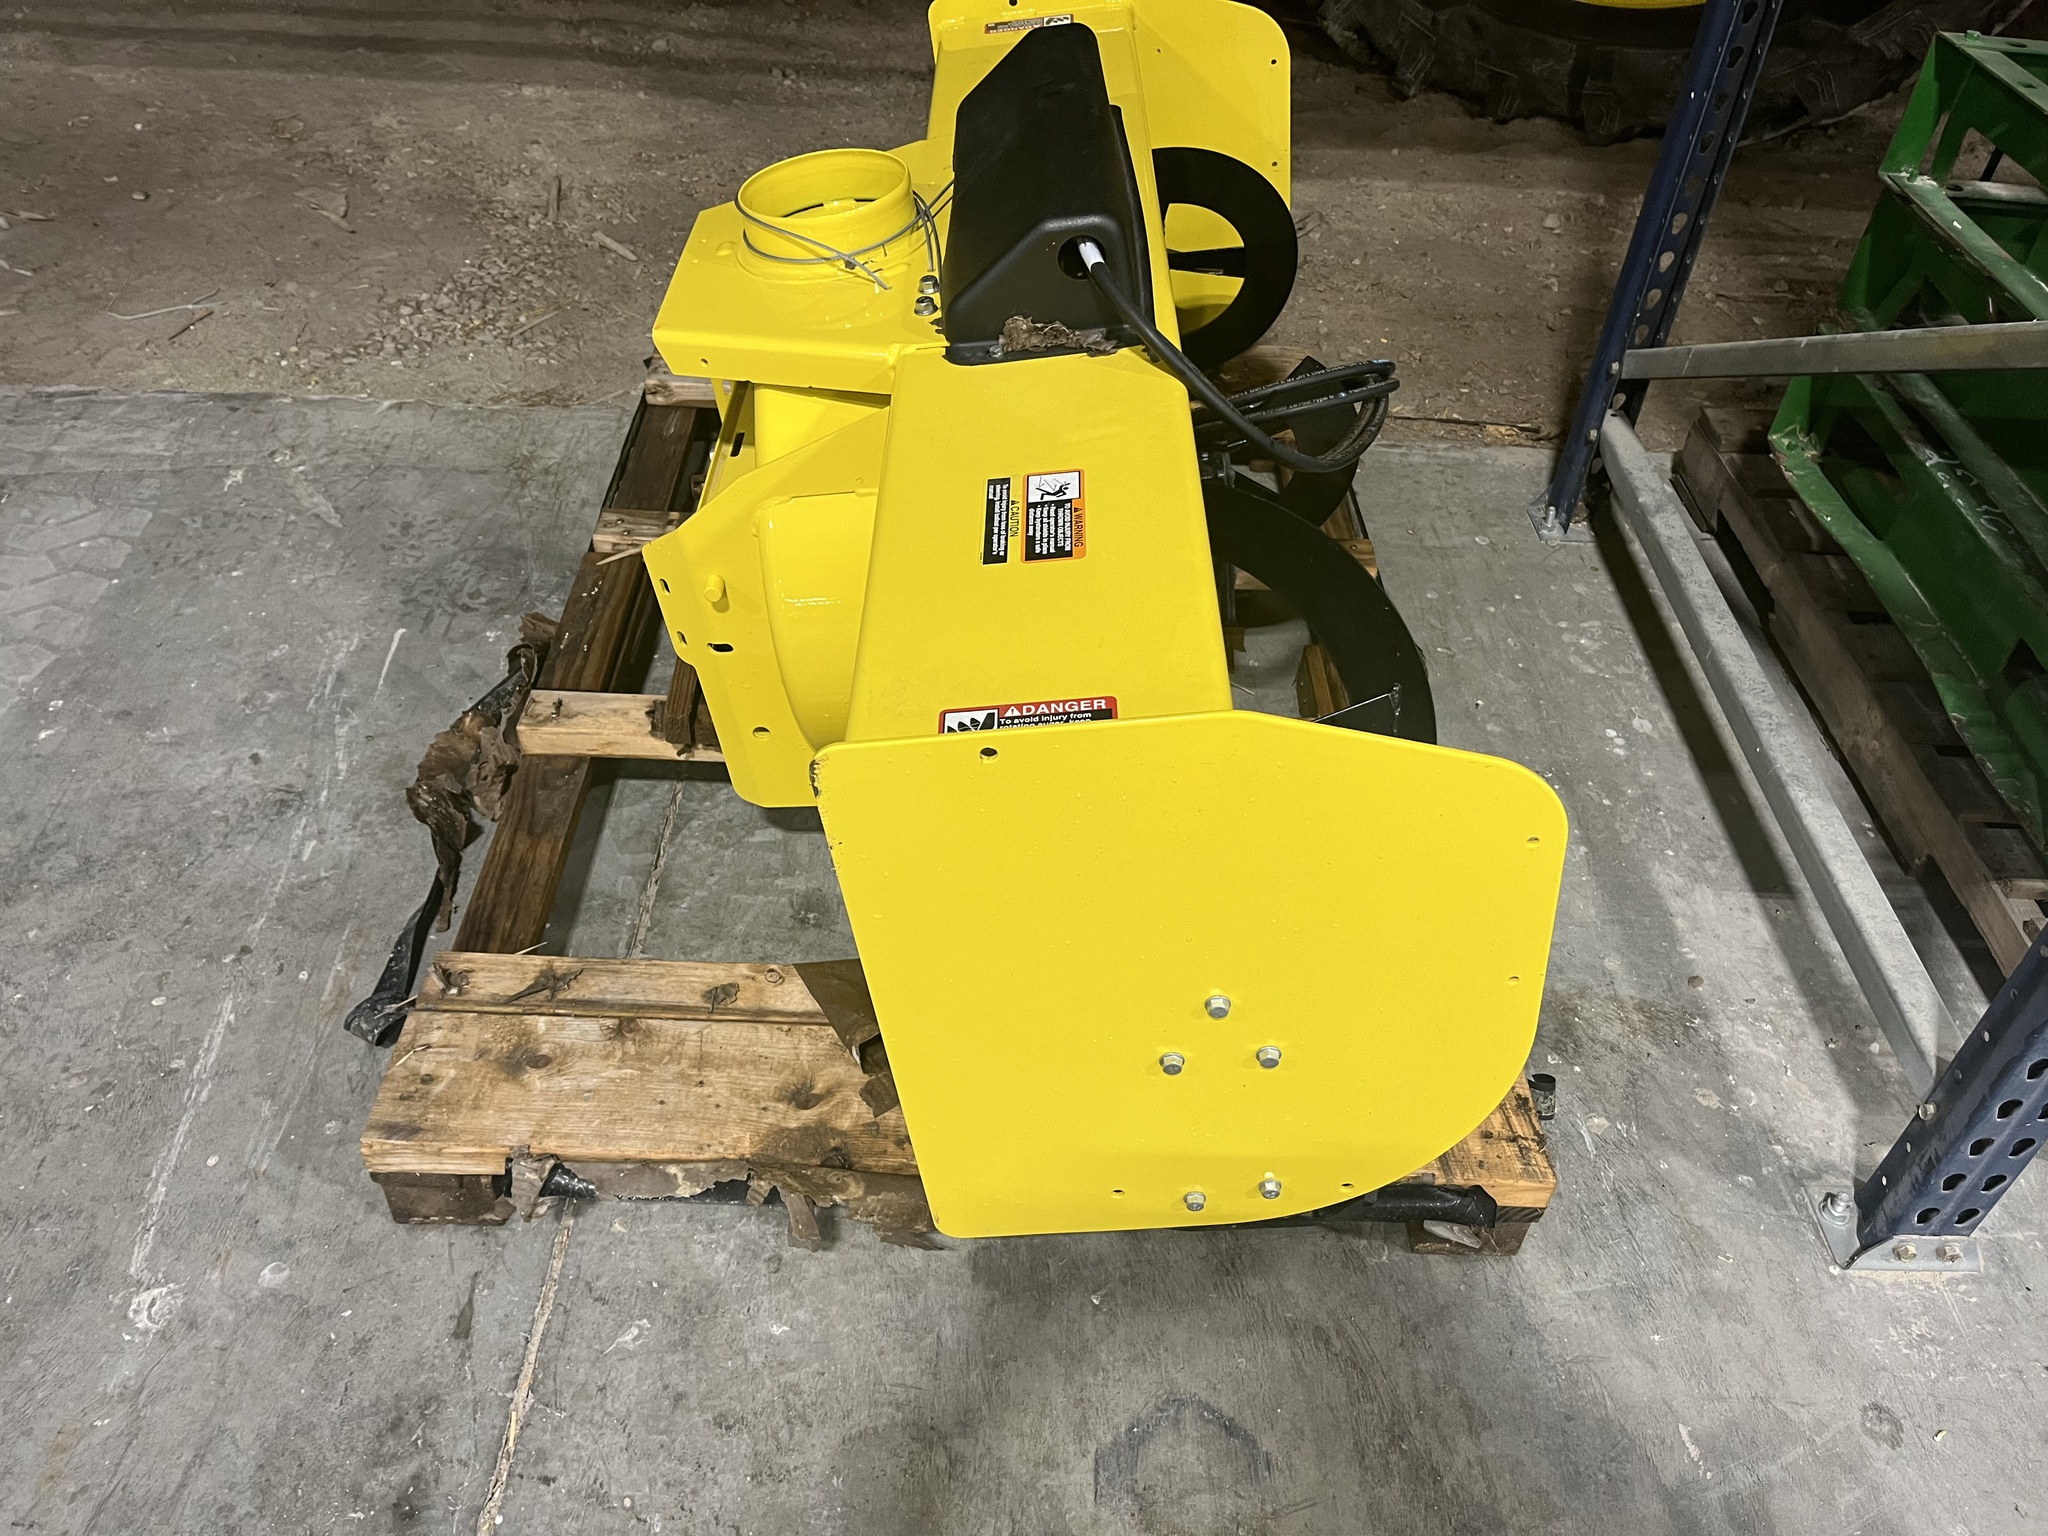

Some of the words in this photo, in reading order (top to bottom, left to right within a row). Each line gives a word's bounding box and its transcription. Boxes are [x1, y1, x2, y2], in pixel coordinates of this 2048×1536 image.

[1010, 506, 1019, 537] CAUTION
[1074, 513, 1083, 547] WARNING
[1022, 699, 1106, 716] DANGER
